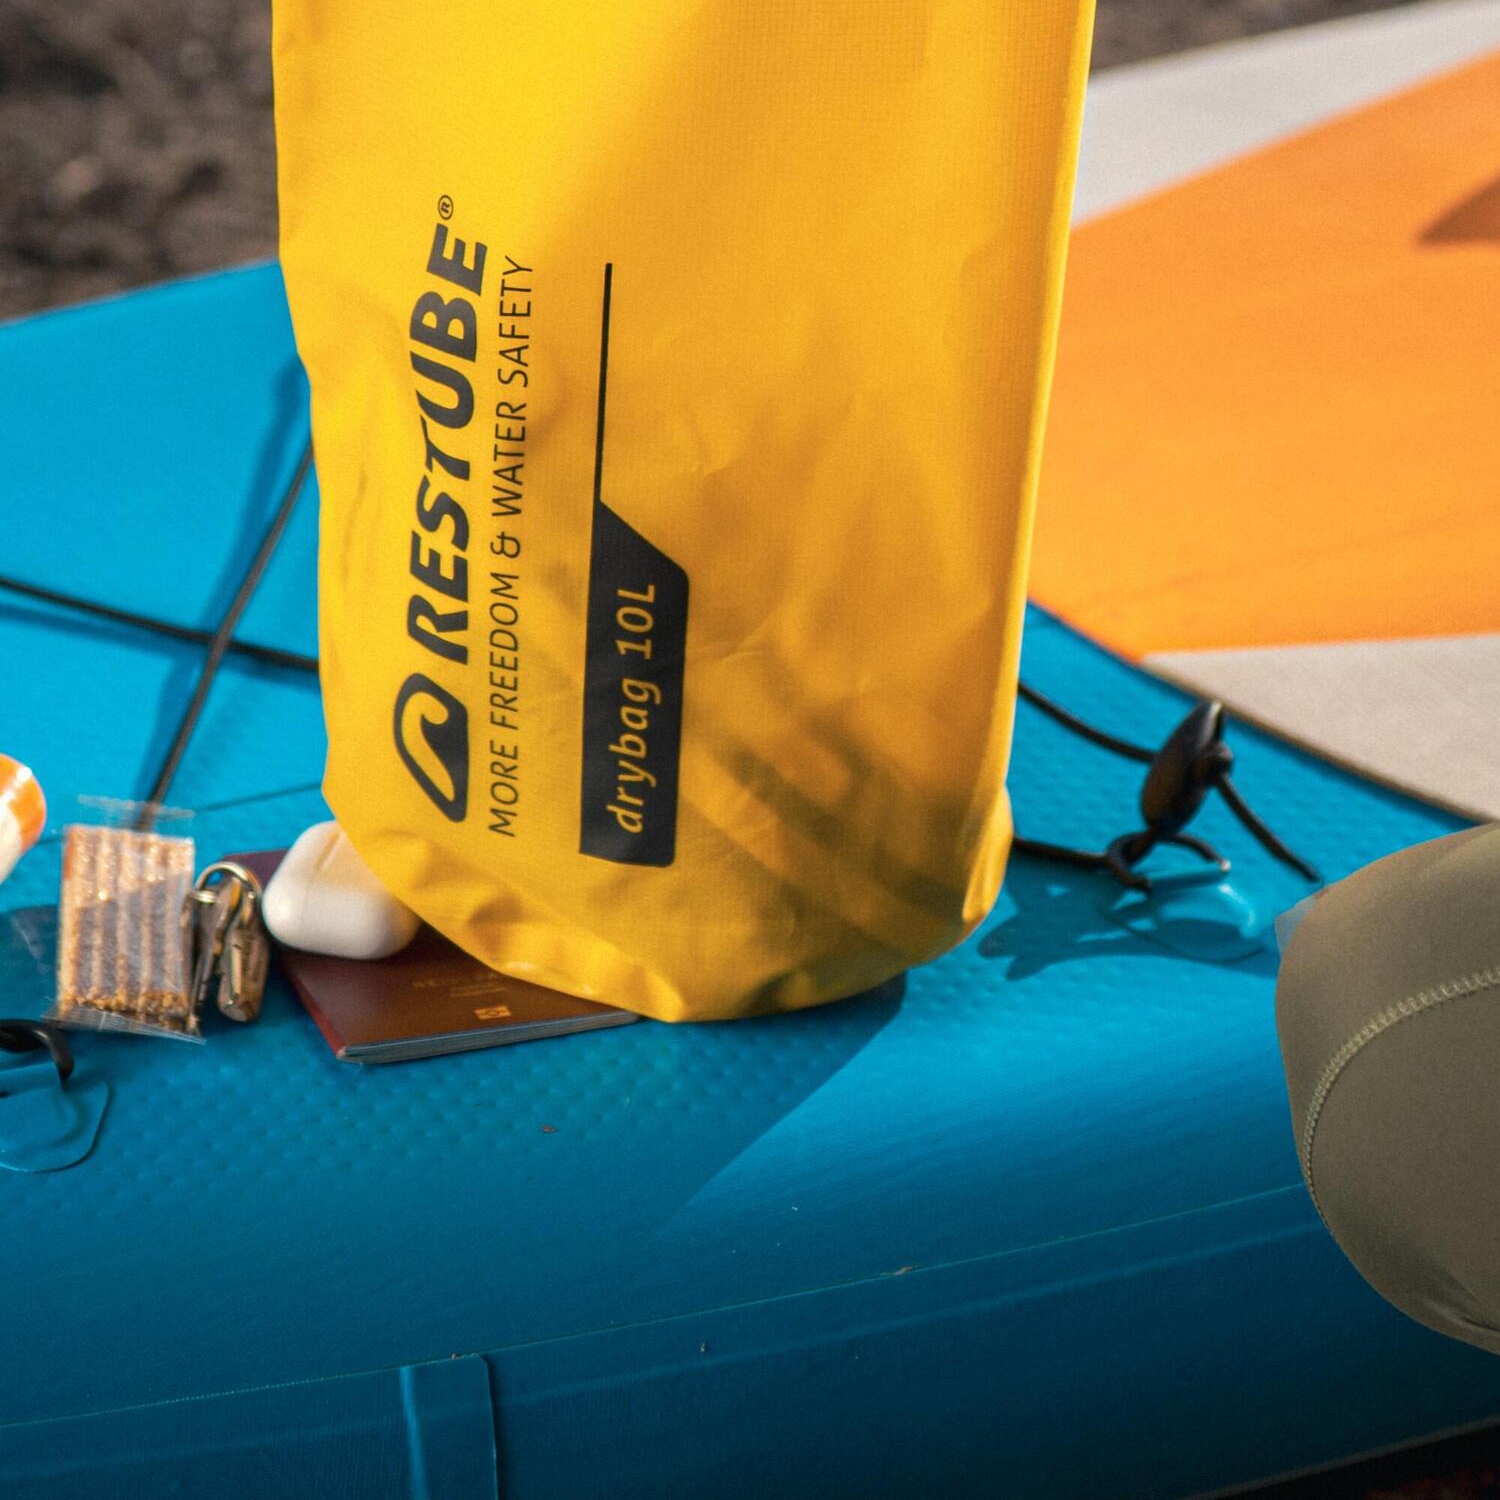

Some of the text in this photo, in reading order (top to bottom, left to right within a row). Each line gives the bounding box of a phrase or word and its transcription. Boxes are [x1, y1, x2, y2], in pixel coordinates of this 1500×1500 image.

[489, 255, 534, 837] MORE FREEDOM & WATER SAFETY
[606, 585, 661, 834] drybag 10L
